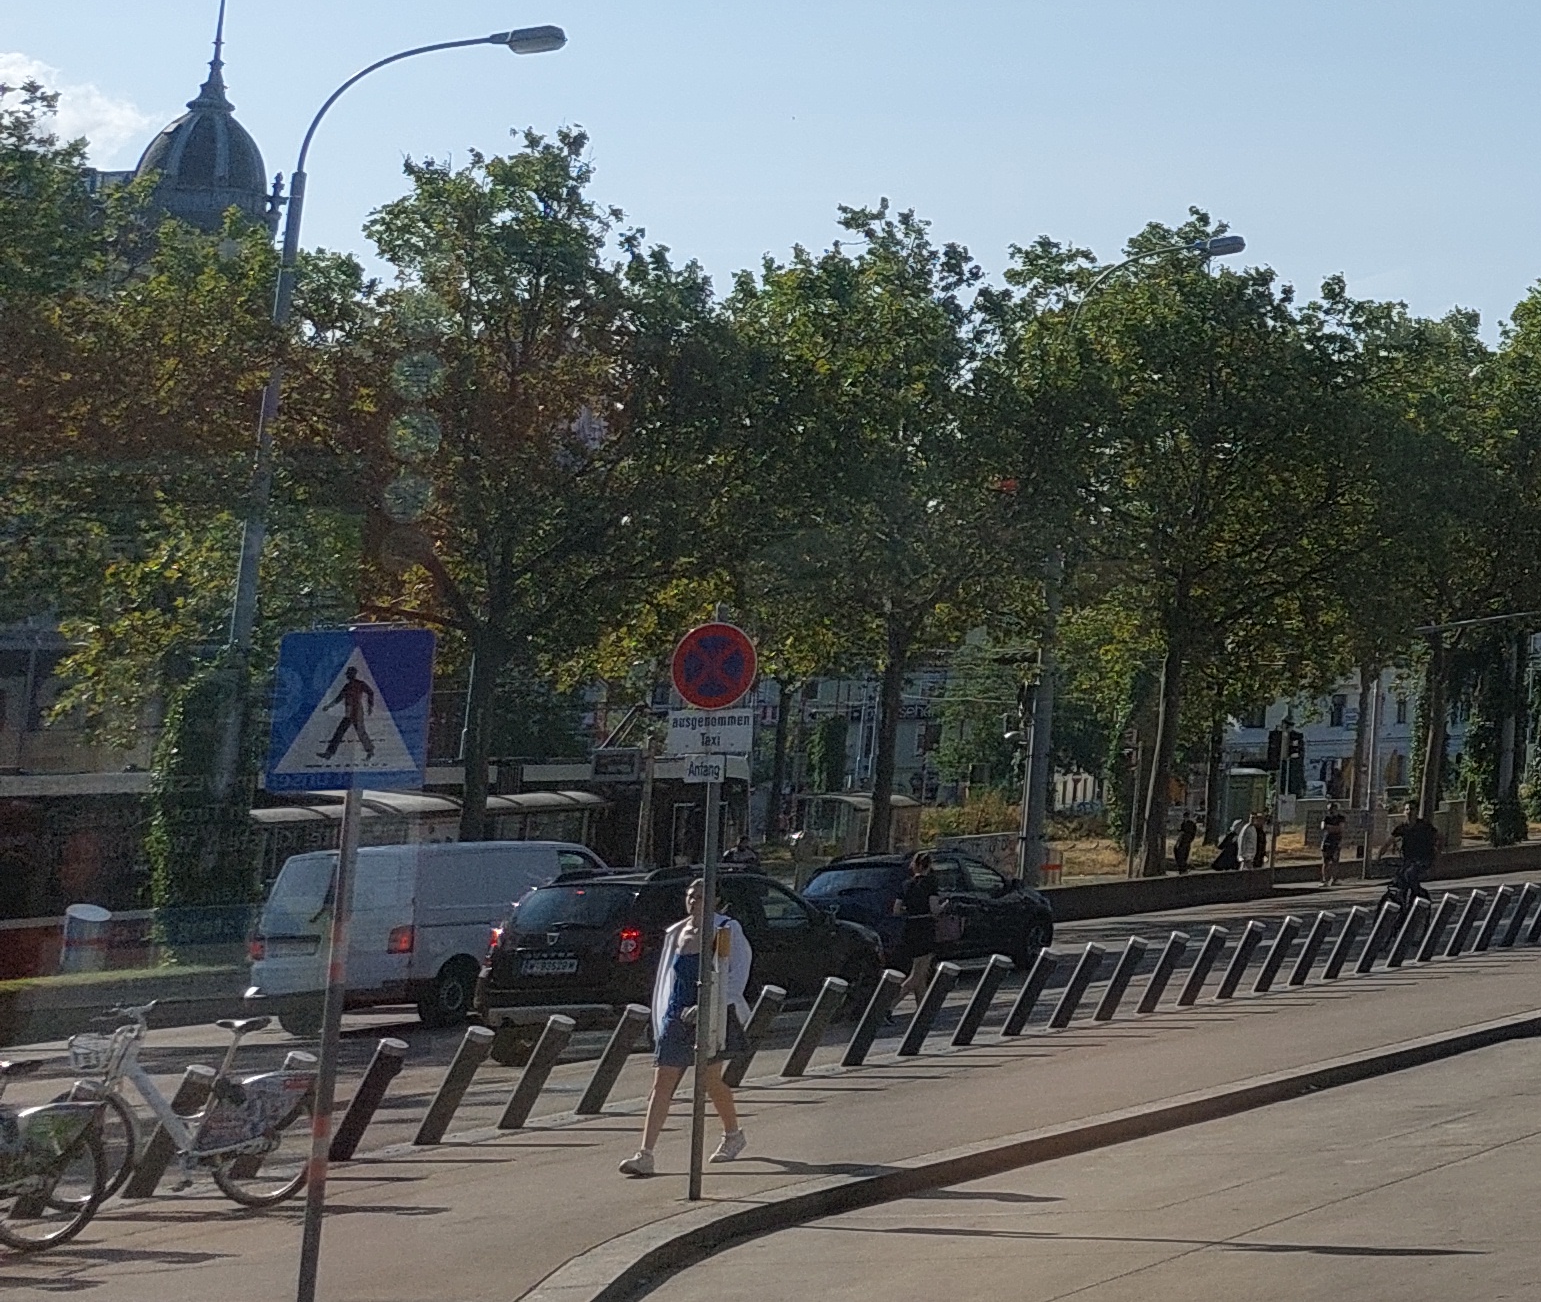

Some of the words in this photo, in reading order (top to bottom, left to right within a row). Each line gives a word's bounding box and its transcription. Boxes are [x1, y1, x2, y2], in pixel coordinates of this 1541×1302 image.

[671, 715, 750, 731] ausgenommen
[700, 731, 721, 747] Taxi
[688, 761, 720, 780] Anfang
